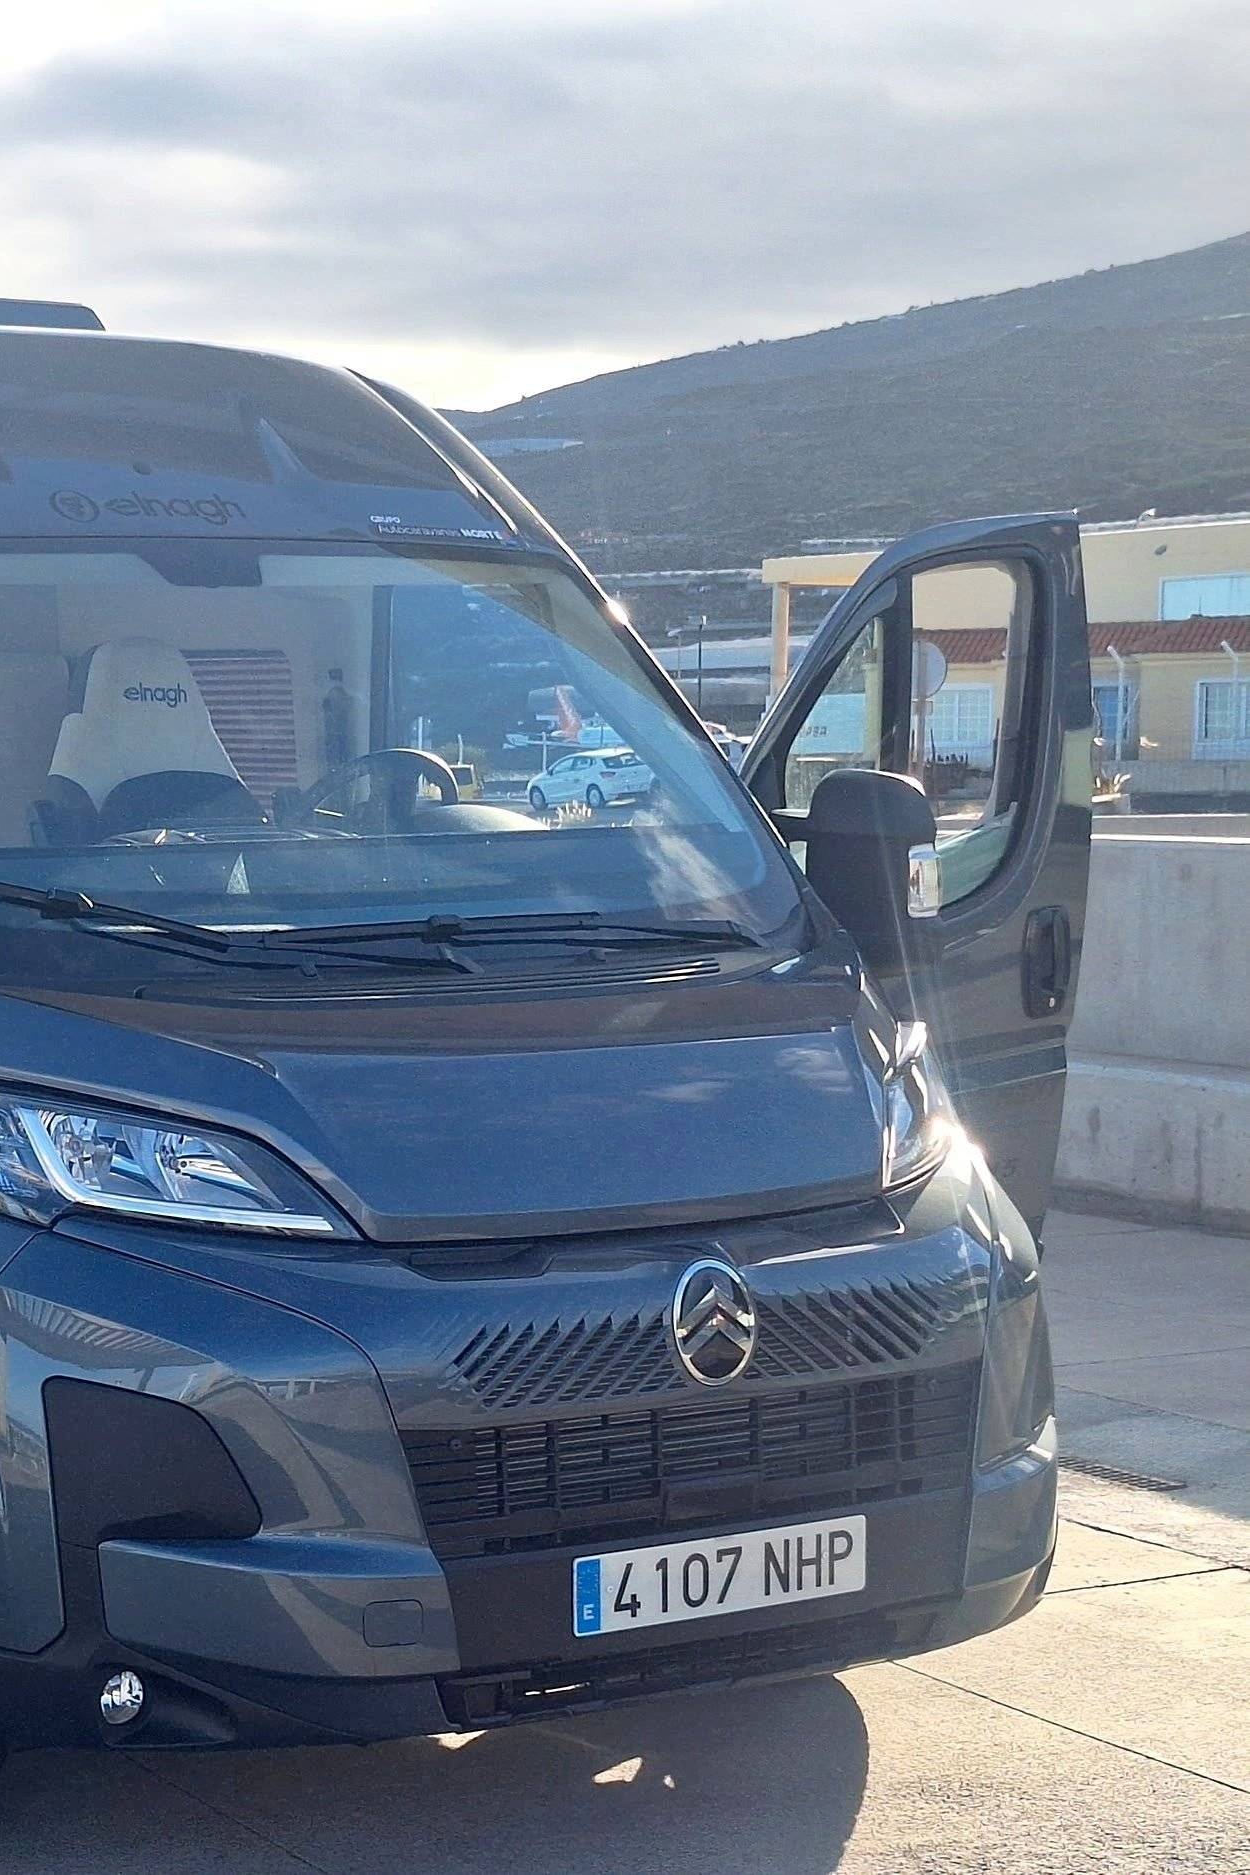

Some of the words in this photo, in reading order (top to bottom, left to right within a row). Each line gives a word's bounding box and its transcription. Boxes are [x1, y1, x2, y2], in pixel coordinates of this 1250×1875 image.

[104, 490, 247, 525] elnagh
[460, 528, 503, 540] NORTE
[123, 682, 187, 708] elnagh
[613, 1546, 743, 1618] 4107
[763, 1530, 854, 1596] NHP
[583, 1603, 595, 1621] E
